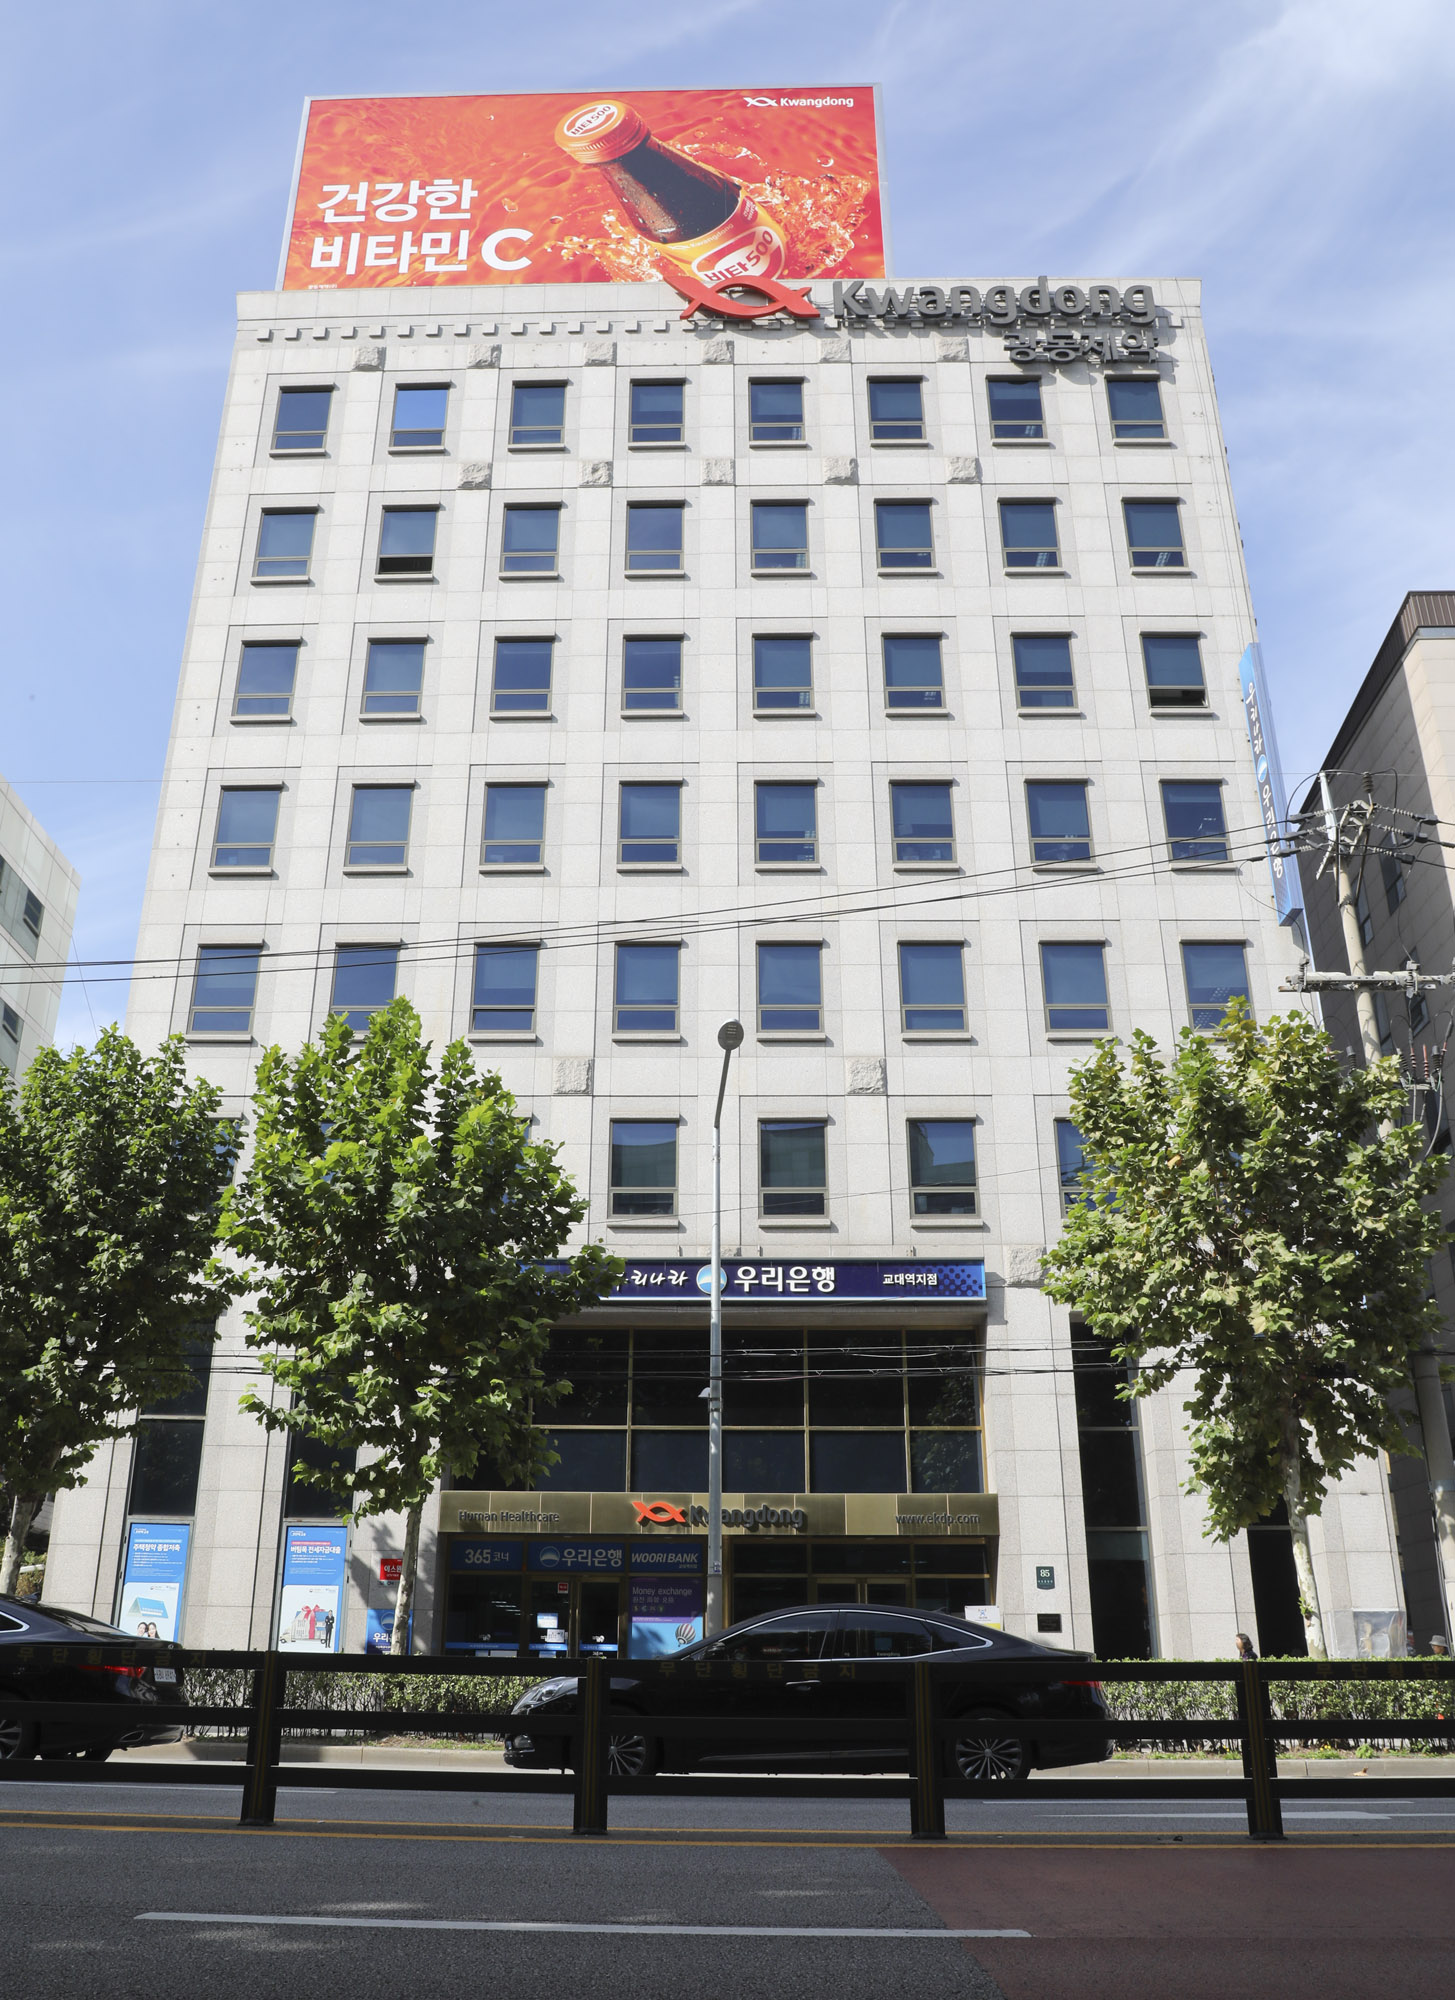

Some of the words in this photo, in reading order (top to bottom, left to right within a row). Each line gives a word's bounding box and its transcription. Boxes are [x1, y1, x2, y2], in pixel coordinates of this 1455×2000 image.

[780, 97, 854, 108] Kwangdong
[570, 105, 612, 136] 비타500
[317, 179, 478, 223] 건강한
[310, 229, 470, 275] 비타민
[481, 228, 534, 271] C
[704, 230, 773, 281] 비타500
[832, 276, 1157, 325] Kwangdong
[1003, 331, 1160, 364] 광동제약
[616, 1269, 688, 1291] 리나라
[734, 1266, 835, 1292] 우리은행
[883, 1273, 937, 1286] 교대역지점
[458, 1510, 498, 1522] Human
[500, 1510, 560, 1522] Healthcare
[895, 1512, 980, 1527] www.ekdp.com
[464, 1549, 491, 1564] 365
[561, 1548, 623, 1567] 우리은행
[631, 1553, 667, 1564] WOORI
[668, 1553, 699, 1564] BANK
[1039, 1569, 1051, 1578] 85
[632, 1587, 656, 1597] Money
[658, 1587, 693, 1598] exchange
